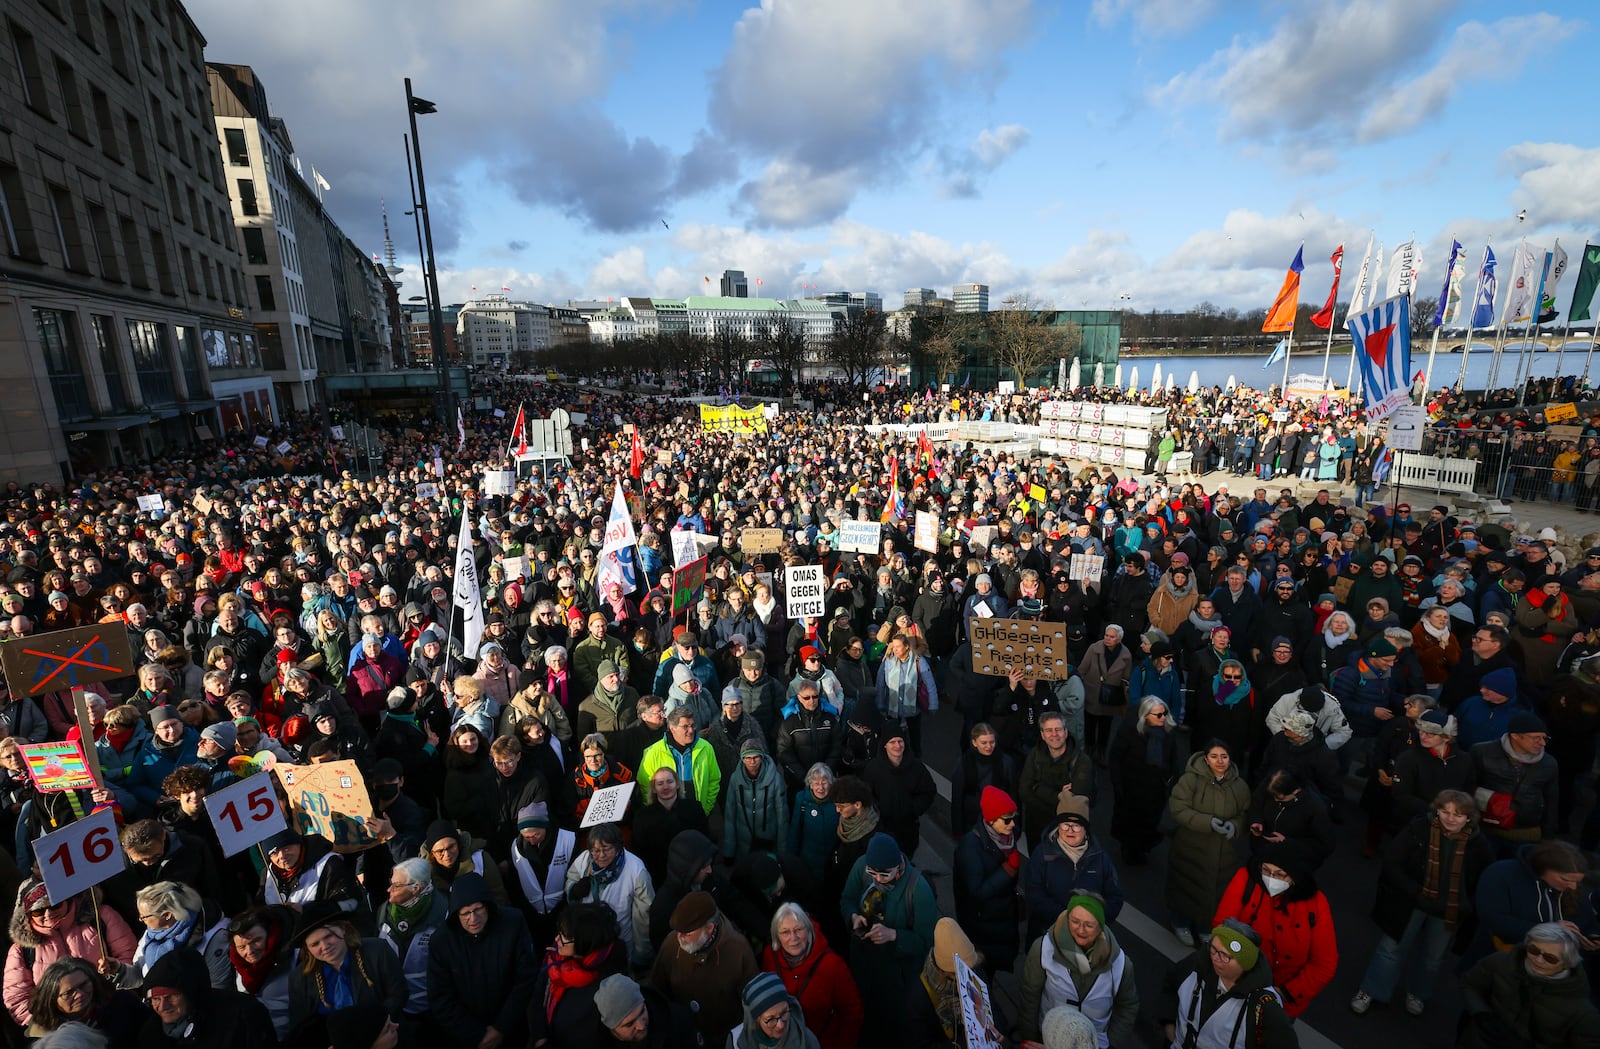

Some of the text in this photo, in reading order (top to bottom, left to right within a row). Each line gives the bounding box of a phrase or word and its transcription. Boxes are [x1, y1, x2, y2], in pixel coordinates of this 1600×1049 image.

[840, 533, 879, 547] GEGEN RECHTS
[792, 569, 817, 582] OMAS
[790, 584, 820, 598] GEGEN
[789, 600, 822, 616] KRIEGE
[974, 627, 1052, 644] GHGegen
[990, 649, 1053, 666] Rechts
[598, 789, 619, 802] OMAS
[219, 786, 275, 832] 15
[592, 799, 617, 812] GEGEN
[587, 809, 615, 822] RECHTS
[48, 826, 114, 878] 16
